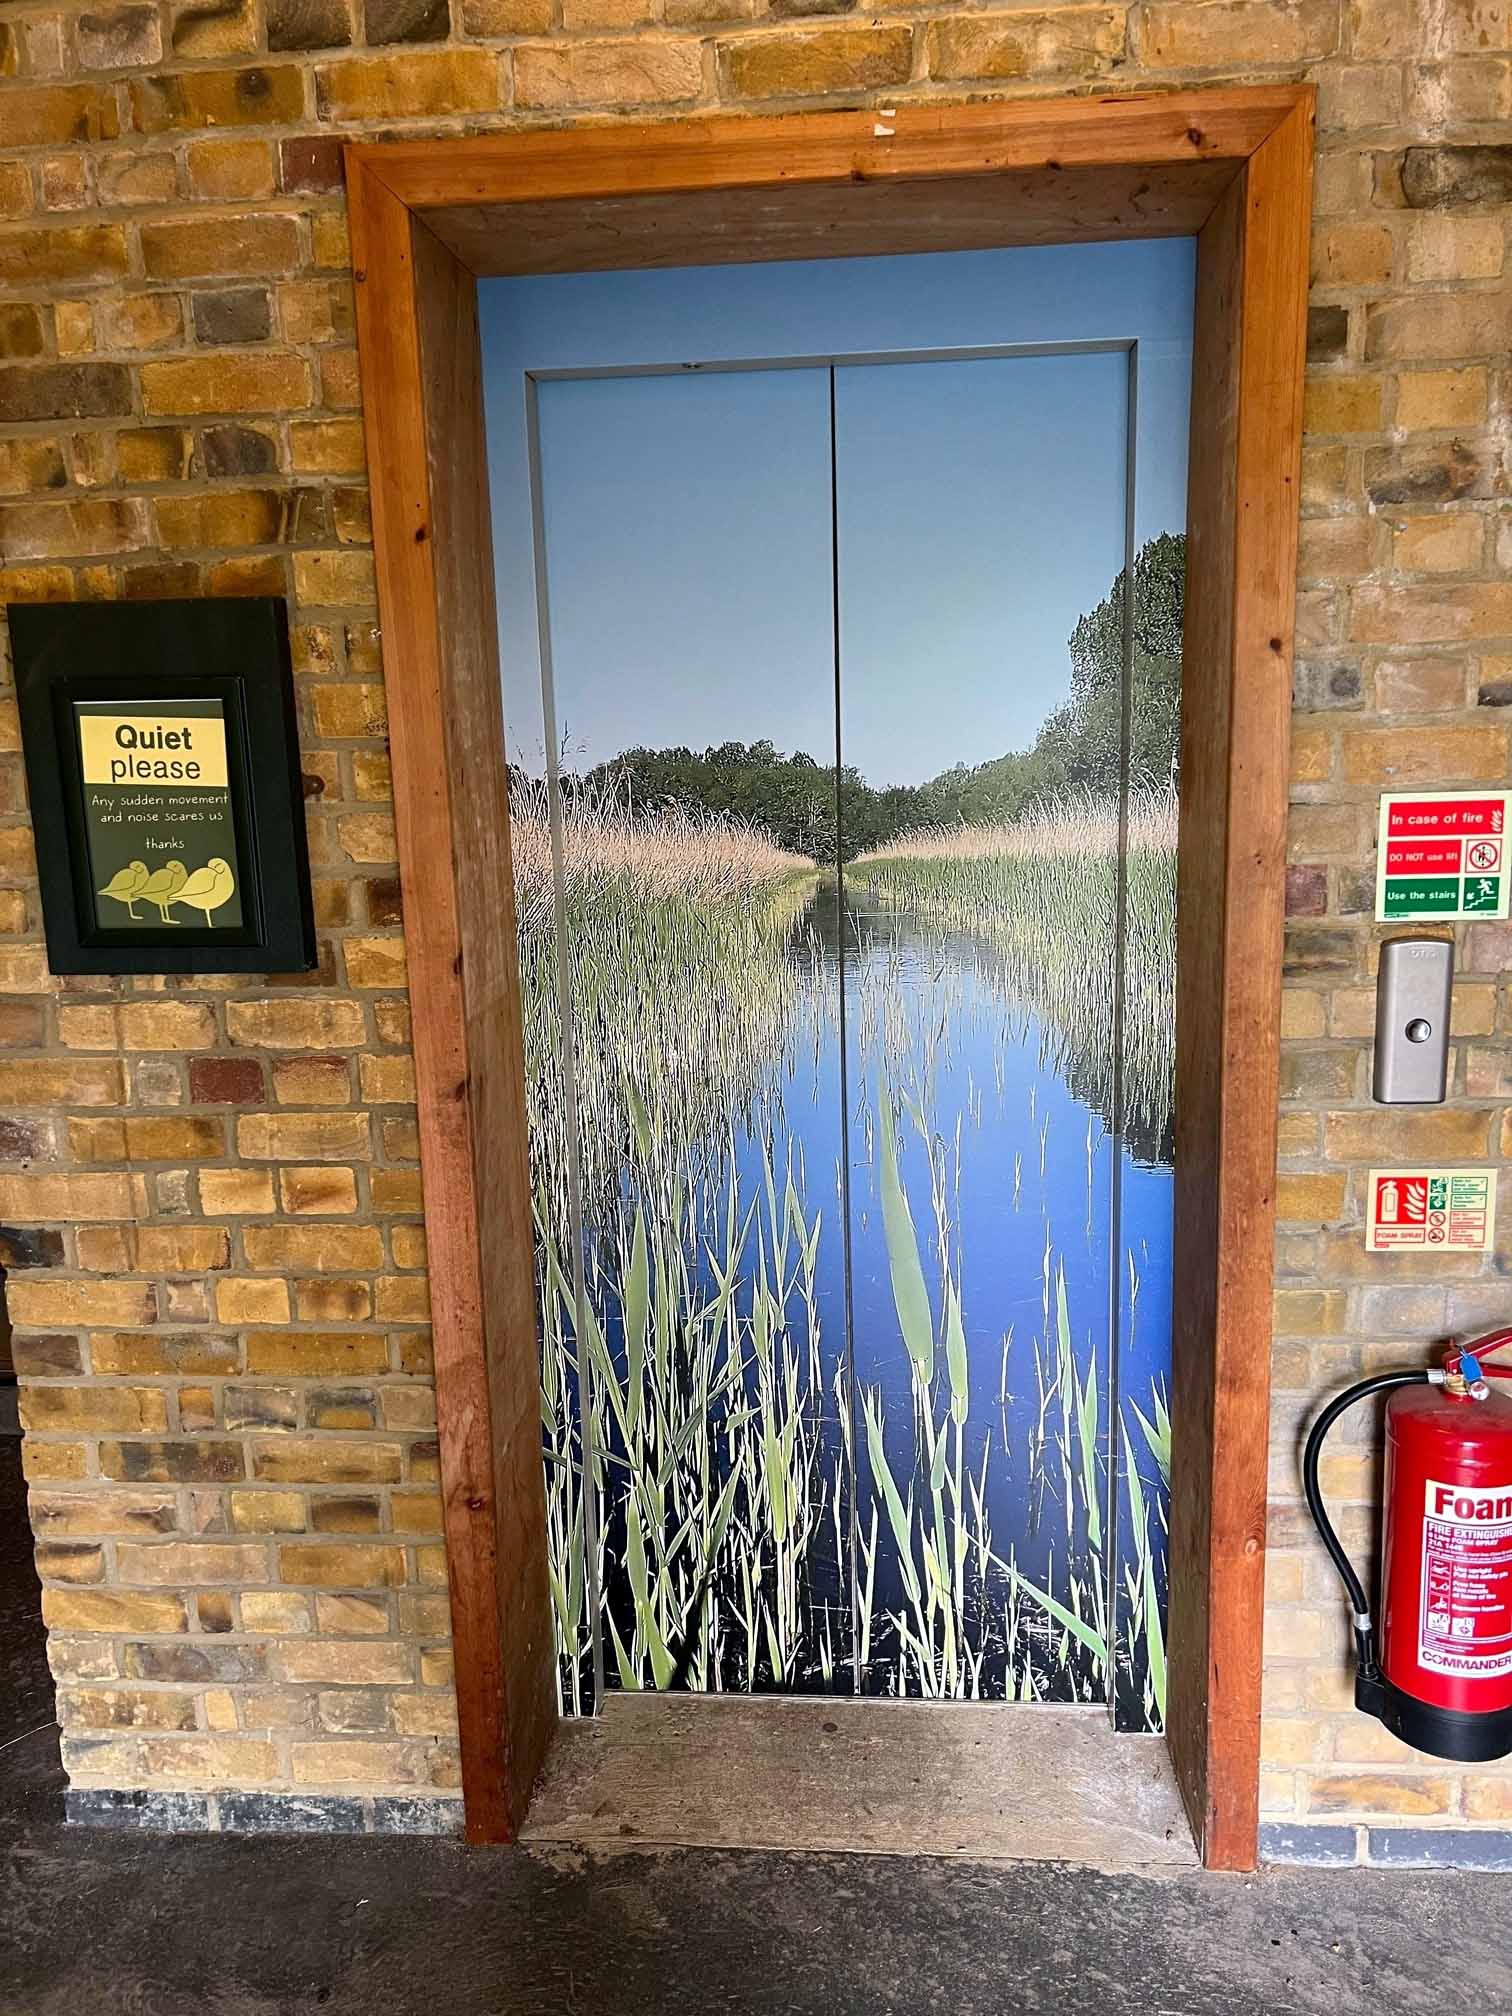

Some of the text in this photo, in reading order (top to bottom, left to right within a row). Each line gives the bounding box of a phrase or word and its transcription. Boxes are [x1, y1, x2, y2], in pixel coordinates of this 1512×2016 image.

[115, 725, 192, 750] Quiet
[111, 754, 201, 783] please
[92, 792, 229, 811] Any sudden movement
[100, 811, 223, 823] and noise scares us
[1392, 812, 1484, 825] In case of fire
[145, 836, 185, 849] thanks
[1389, 853, 1403, 862] DO
[1405, 852, 1424, 861] NOT
[1387, 890, 1456, 900] Use the stairs
[1428, 1522, 1452, 1536] FIRE
[1422, 1650, 1512, 1670] COMMANDER
